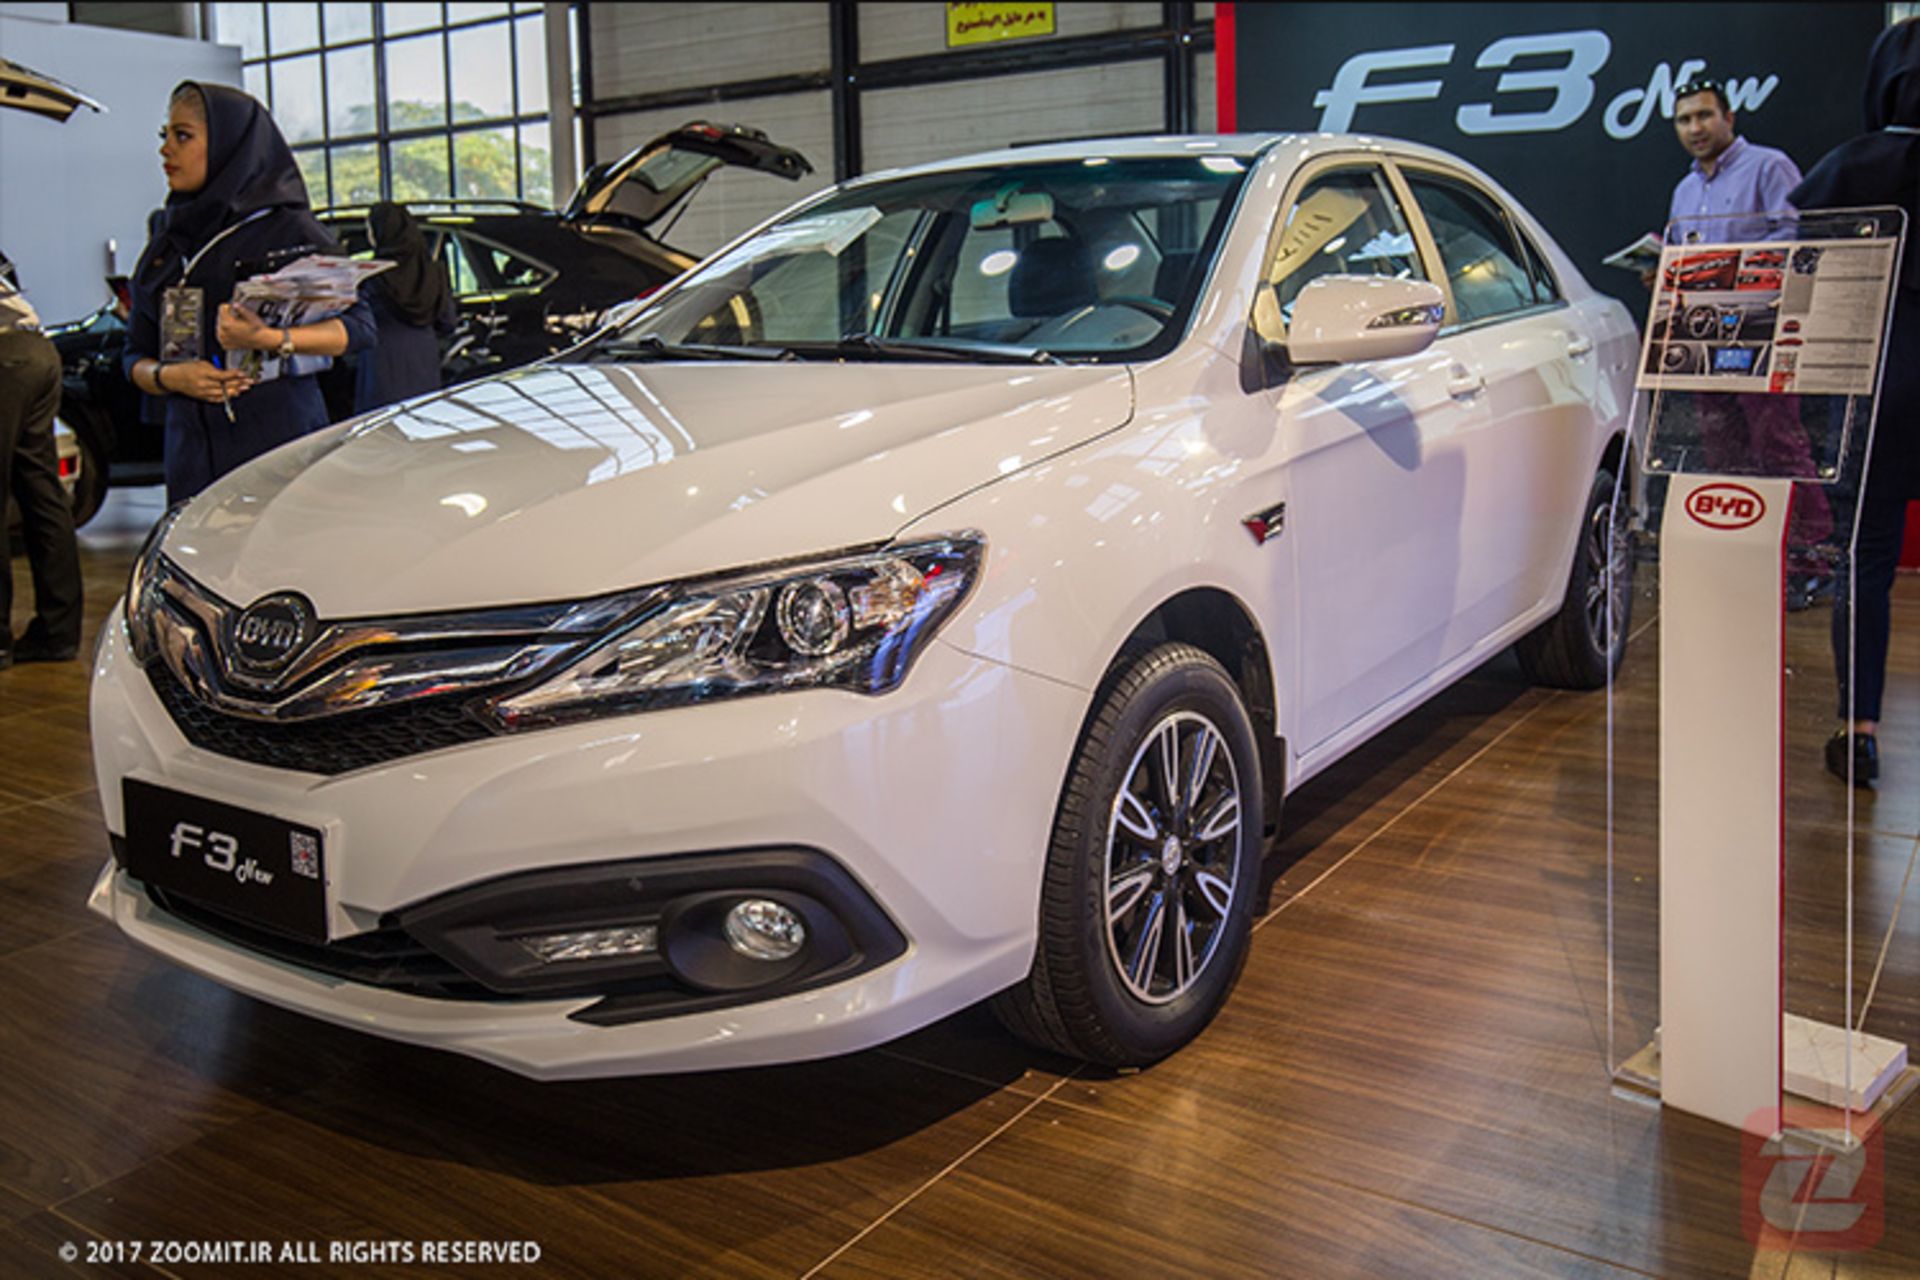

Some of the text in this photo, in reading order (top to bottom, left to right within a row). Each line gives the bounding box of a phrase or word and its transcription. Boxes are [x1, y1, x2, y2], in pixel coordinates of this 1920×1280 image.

[1312, 29, 1779, 140] F3 Nw
[1694, 494, 1755, 518] BYD
[170, 821, 274, 885] F3 New
